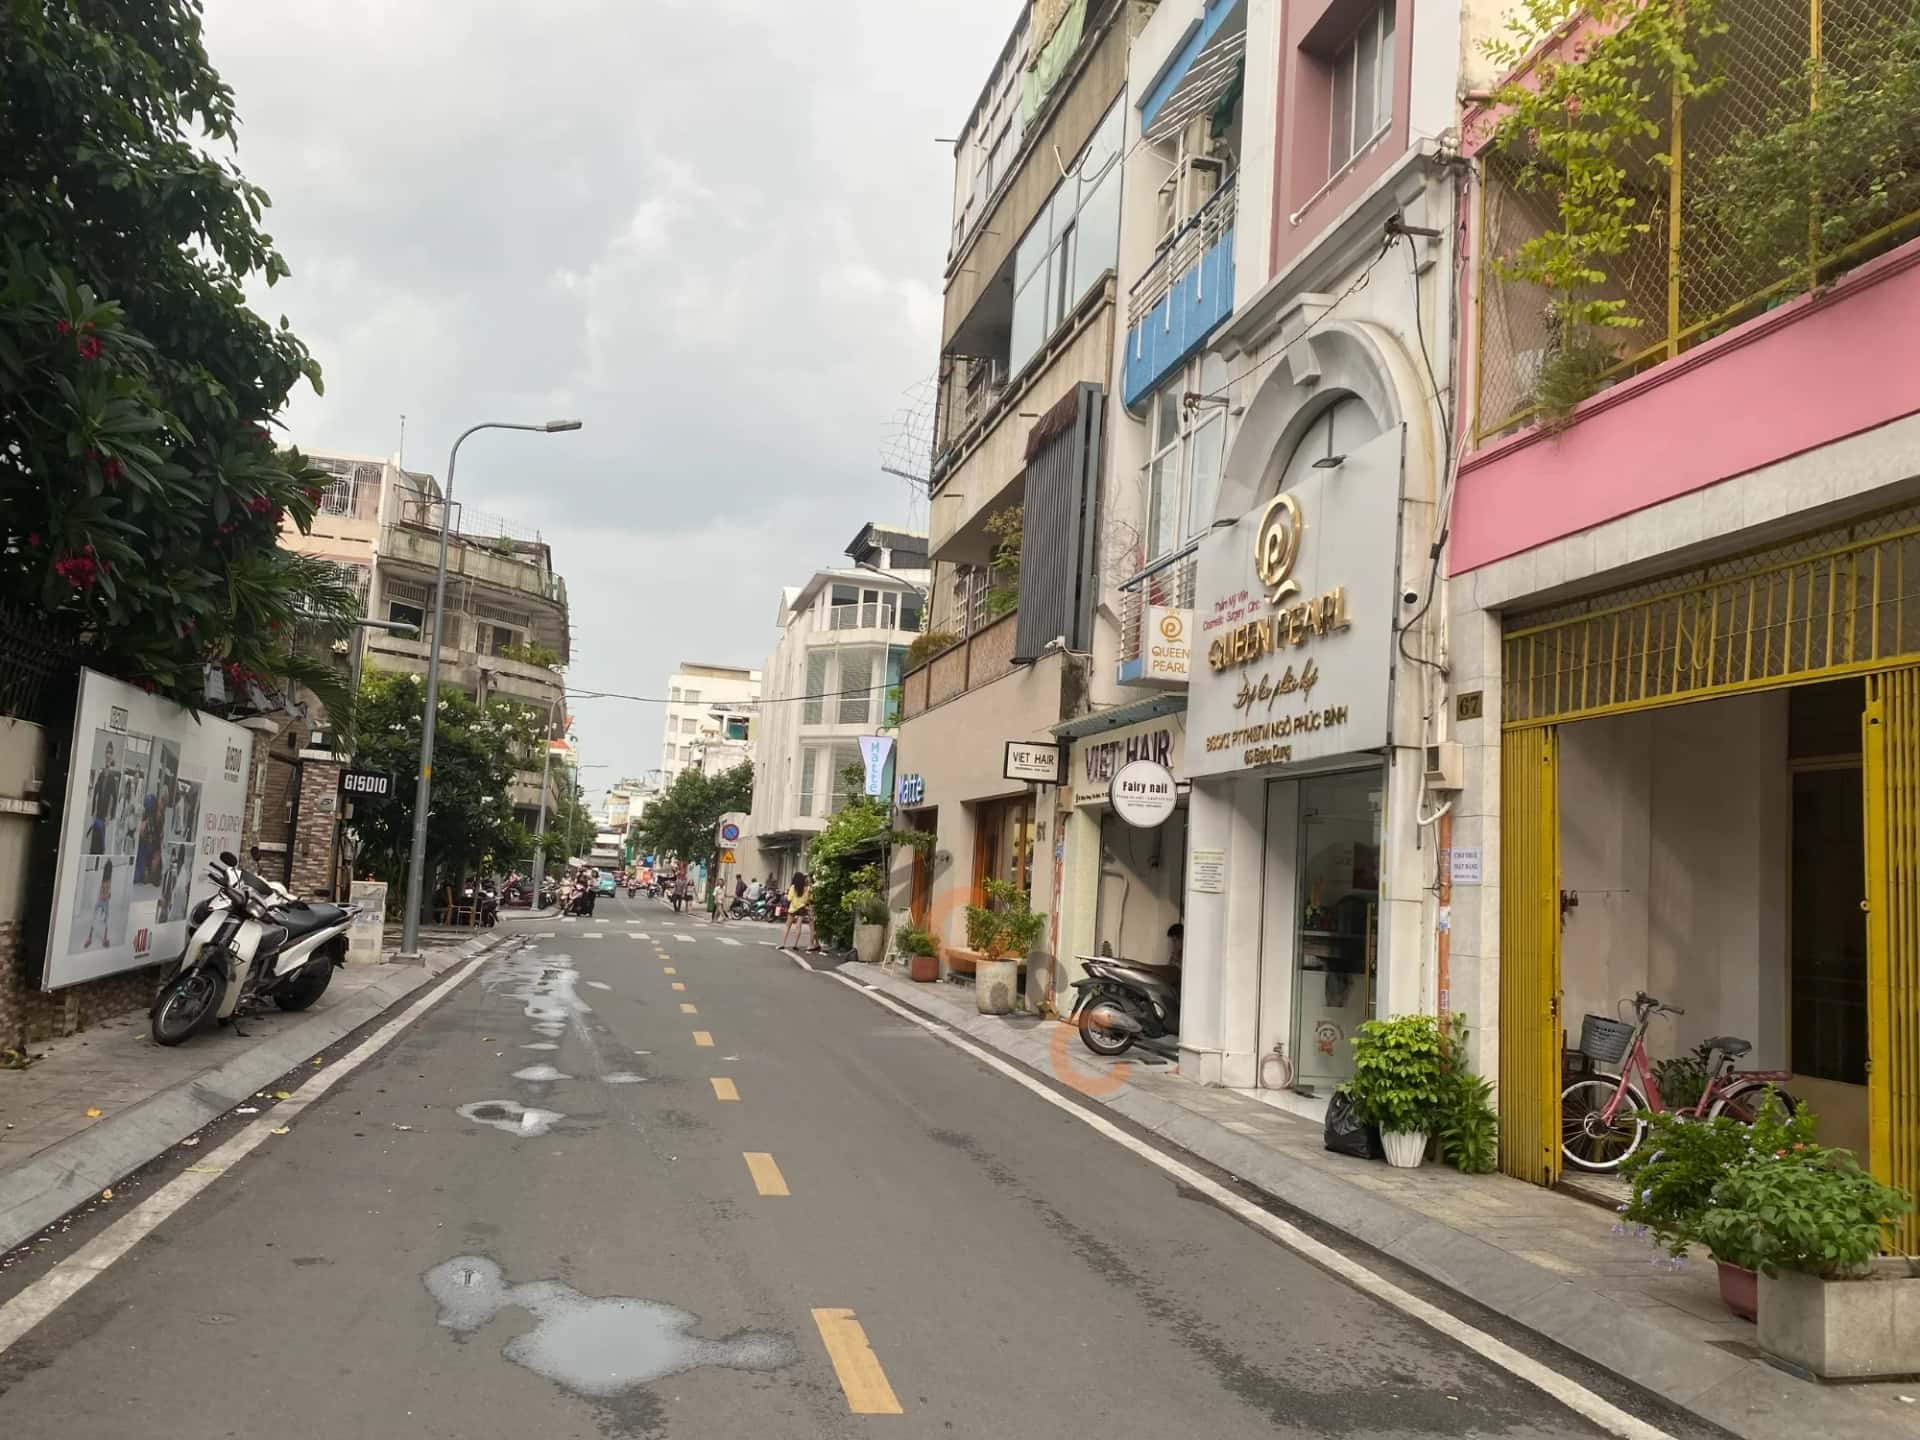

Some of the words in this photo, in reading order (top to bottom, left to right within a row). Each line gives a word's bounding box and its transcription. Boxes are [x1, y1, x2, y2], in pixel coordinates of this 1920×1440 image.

[1208, 615, 1275, 673] QUEEN
[1277, 584, 1353, 649] PEARL
[1151, 646, 1191, 659] QUEEN
[1152, 659, 1187, 673] PEARL
[1460, 695, 1480, 716] 67
[1034, 753, 1055, 767] HAIR
[343, 773, 388, 794] GISDIO
[1122, 780, 1147, 795] Fairy
[1149, 783, 1169, 795] nail
